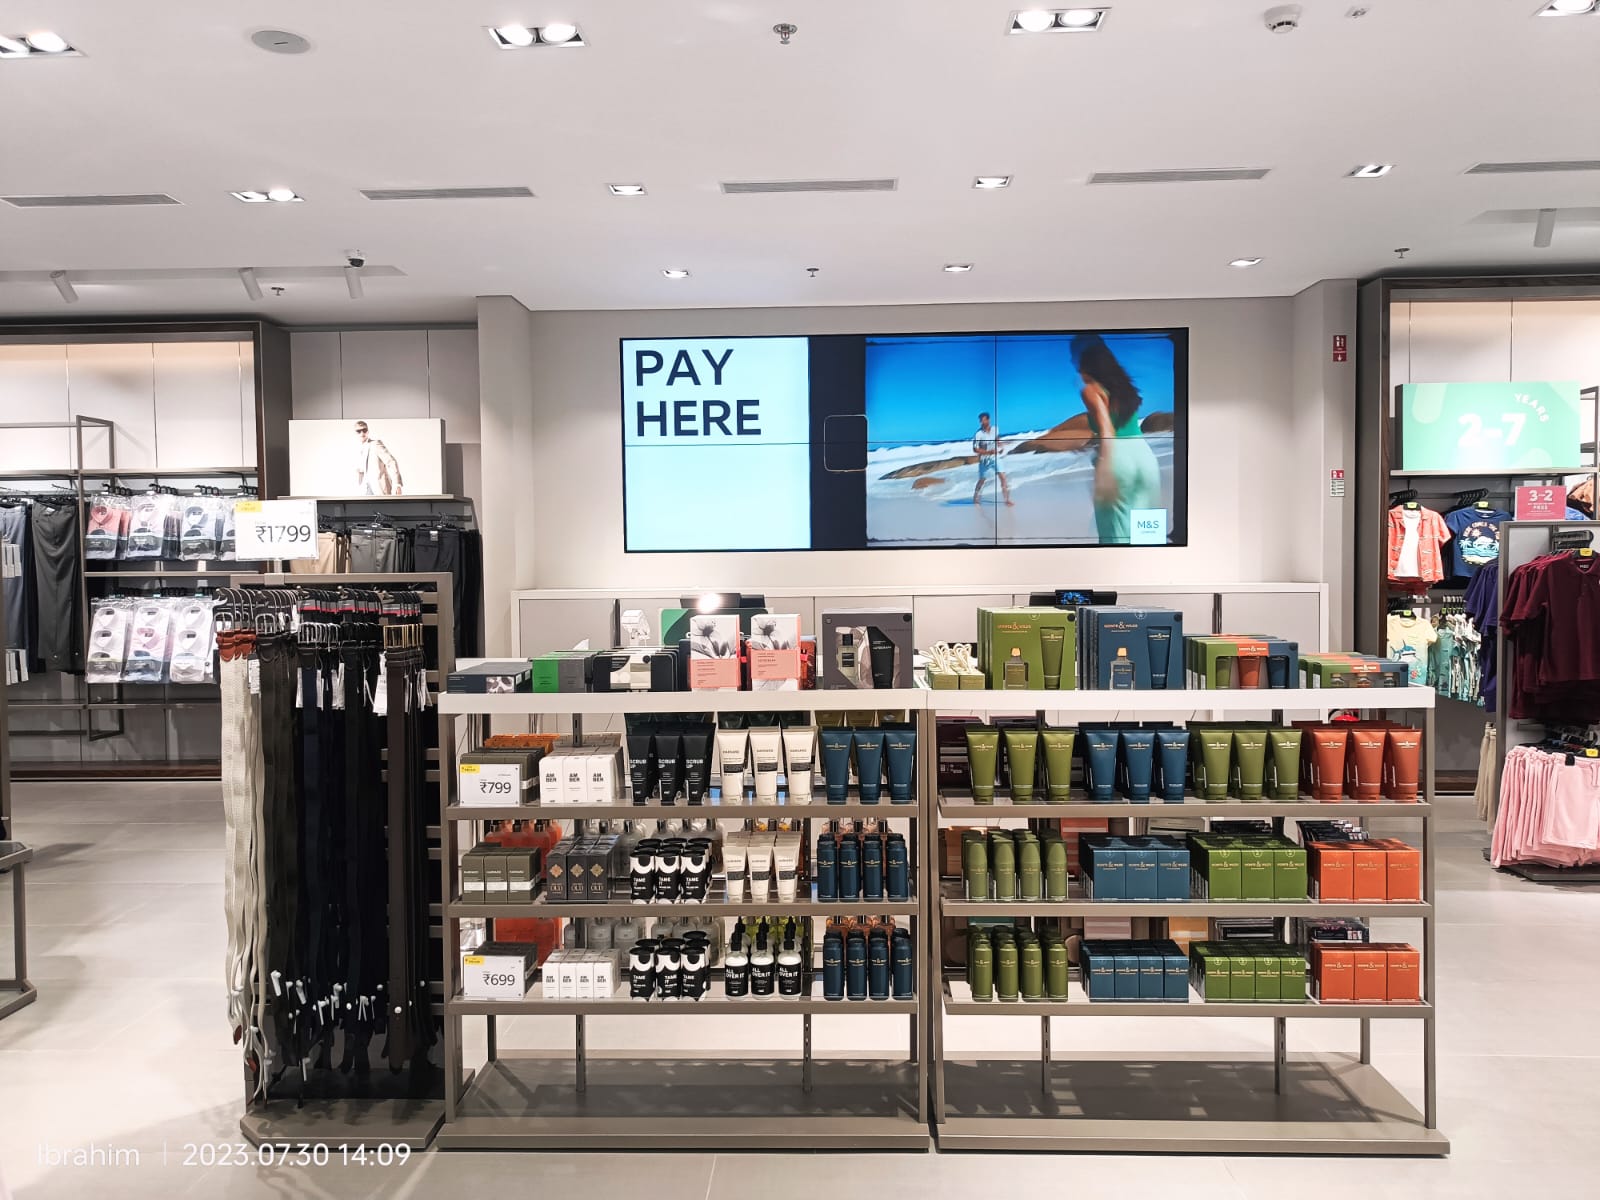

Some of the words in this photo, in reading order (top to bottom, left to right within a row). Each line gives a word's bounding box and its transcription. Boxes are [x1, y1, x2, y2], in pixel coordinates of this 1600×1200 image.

[635, 349, 734, 386] PAY
[1514, 393, 1550, 423] YEARS
[636, 399, 761, 437] HERE
[1457, 411, 1528, 447] 2-7
[1528, 489, 1553, 502] 3-2
[255, 524, 312, 543] ₹1799
[1136, 520, 1160, 529] M&S
[480, 782, 512, 794] ₹799
[482, 974, 516, 986] ₹699
